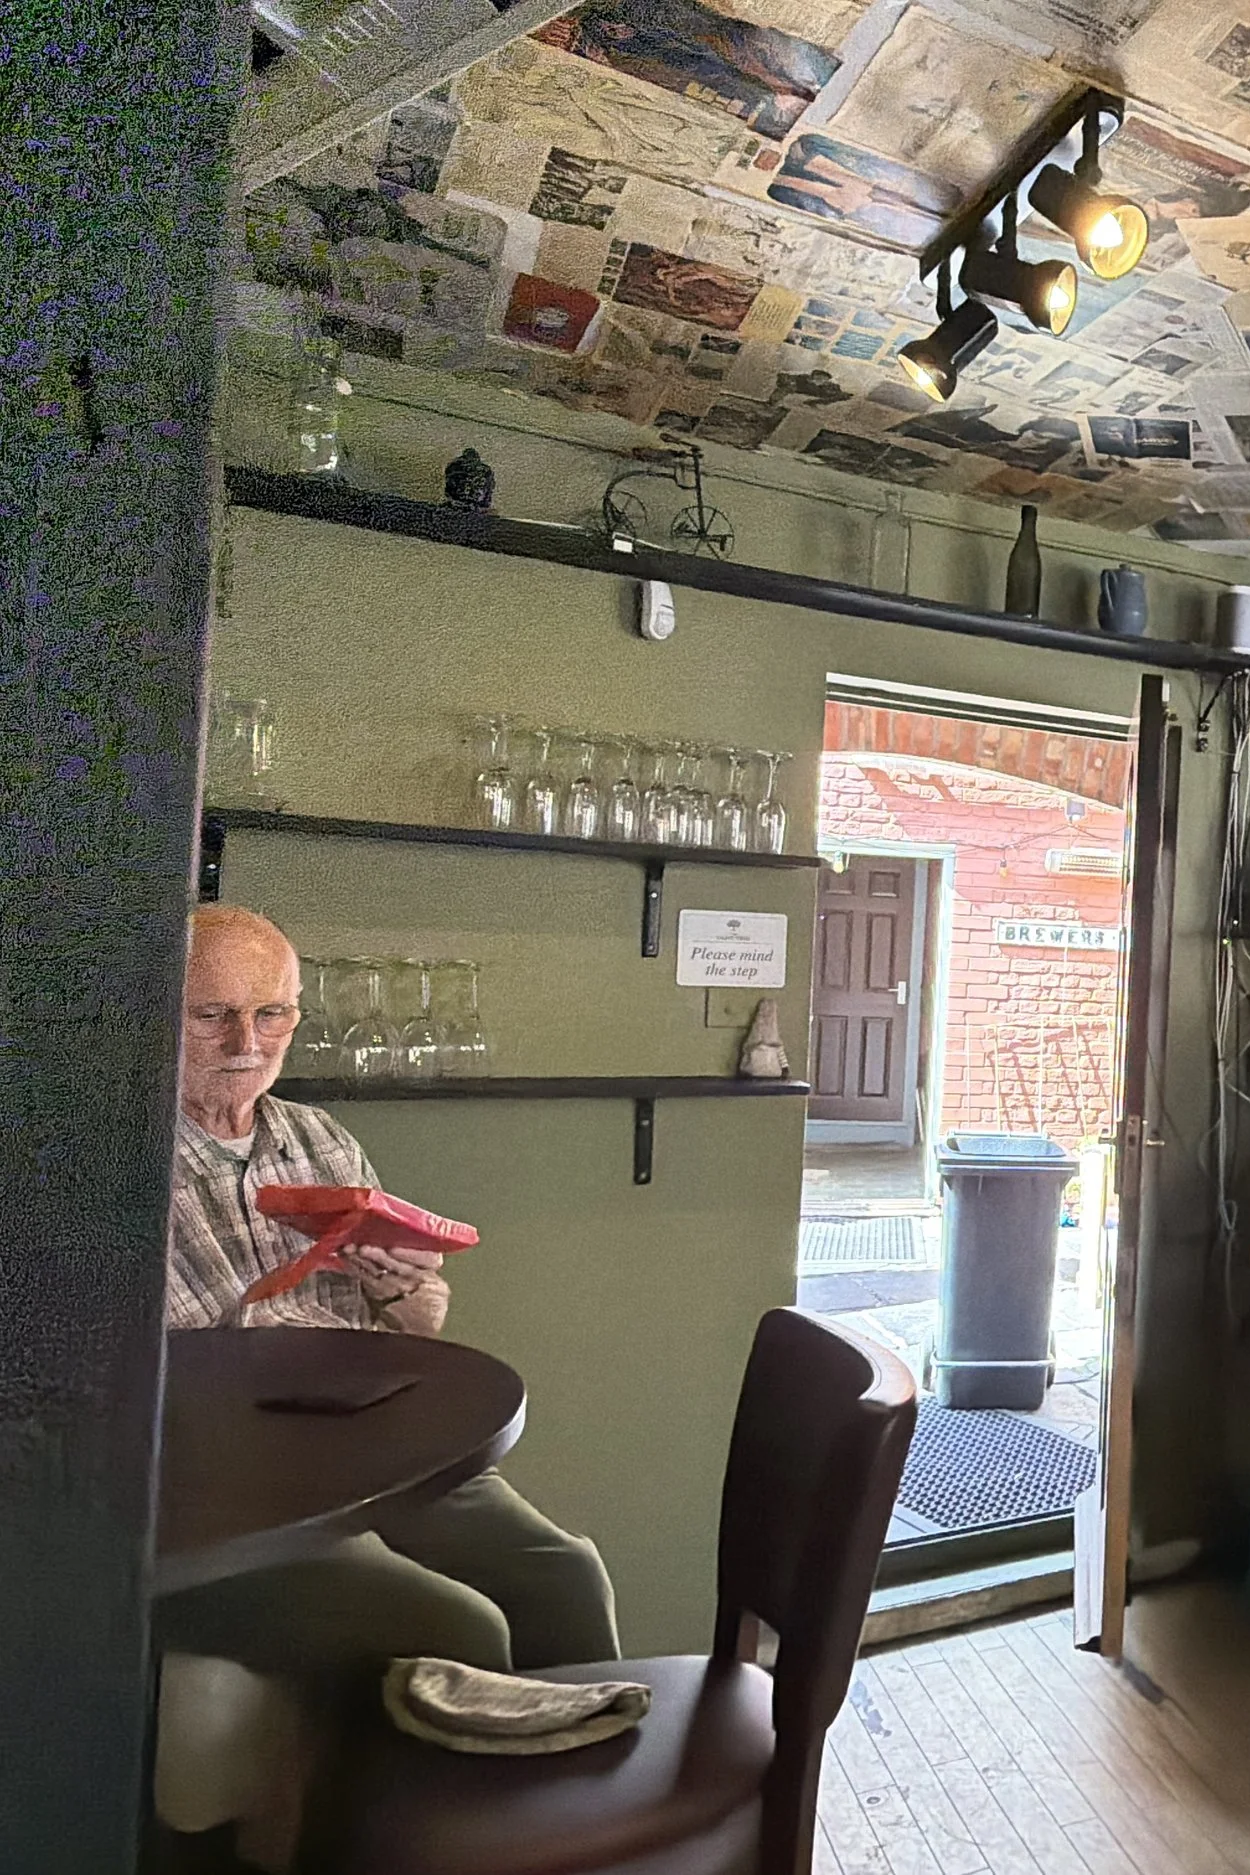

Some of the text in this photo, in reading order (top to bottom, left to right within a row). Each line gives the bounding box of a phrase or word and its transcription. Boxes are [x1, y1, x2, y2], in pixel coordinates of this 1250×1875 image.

[1004, 926, 1105, 946] BREWERS
[690, 946, 775, 962] Please mind
[705, 962, 758, 980] the step
